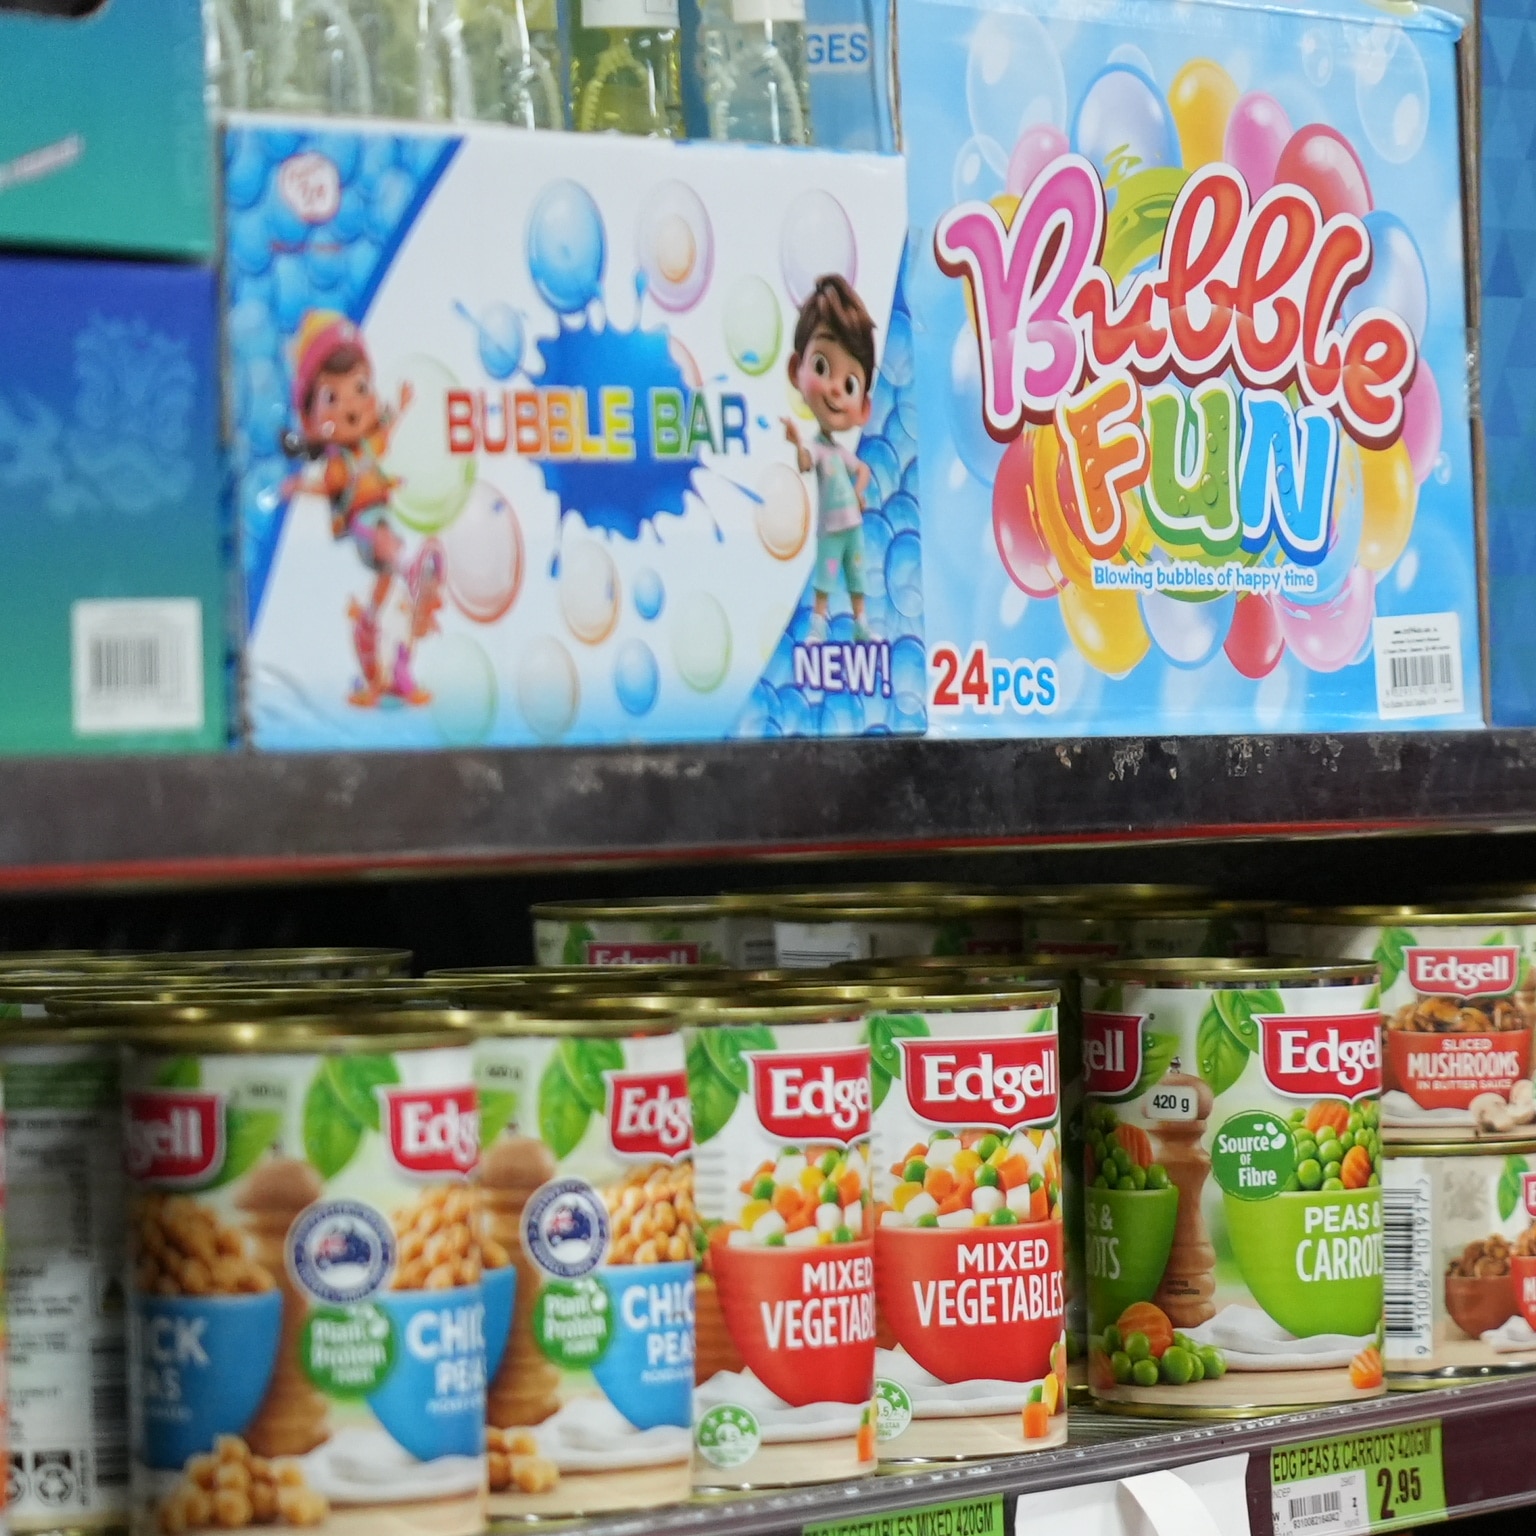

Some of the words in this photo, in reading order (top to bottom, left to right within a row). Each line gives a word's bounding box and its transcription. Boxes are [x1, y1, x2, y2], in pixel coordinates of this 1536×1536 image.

[938, 158, 1415, 440] Bubble
[446, 388, 637, 460] BUBBLE
[653, 391, 751, 456] BAR
[1060, 374, 1336, 560] FUN
[1094, 567, 1153, 588] Blowing
[1157, 567, 1214, 586] bubbles
[1217, 568, 1233, 586] of
[1236, 568, 1281, 589] happy
[1284, 570, 1314, 586] time
[794, 641, 893, 697] NEW!
[1416, 956, 1508, 989] Edgell
[1442, 1039, 1492, 1051] SLICED
[923, 1049, 1056, 1114] Edgell
[1408, 1052, 1519, 1079] MUSHROOMS
[771, 1063, 870, 1128] Edge
[1153, 1094, 1177, 1110] 420
[1181, 1098, 1189, 1112] g
[1218, 1133, 1270, 1156] Source
[1240, 1154, 1251, 1165] OF
[1239, 1167, 1277, 1188] Fibre
[1304, 1203, 1367, 1234] PEAS
[957, 1239, 1050, 1274] MIXED
[802, 1257, 873, 1294] MIXED
[913, 1270, 1064, 1328] VEGETABLES
[1274, 1451, 1297, 1482] EDG
[1300, 1445, 1329, 1476] PEAS
[1333, 1443, 1340, 1471] &
[1344, 1433, 1395, 1470] CARROTS
[1377, 1467, 1421, 1520] 2.95
[956, 1502, 994, 1536] 420GM
